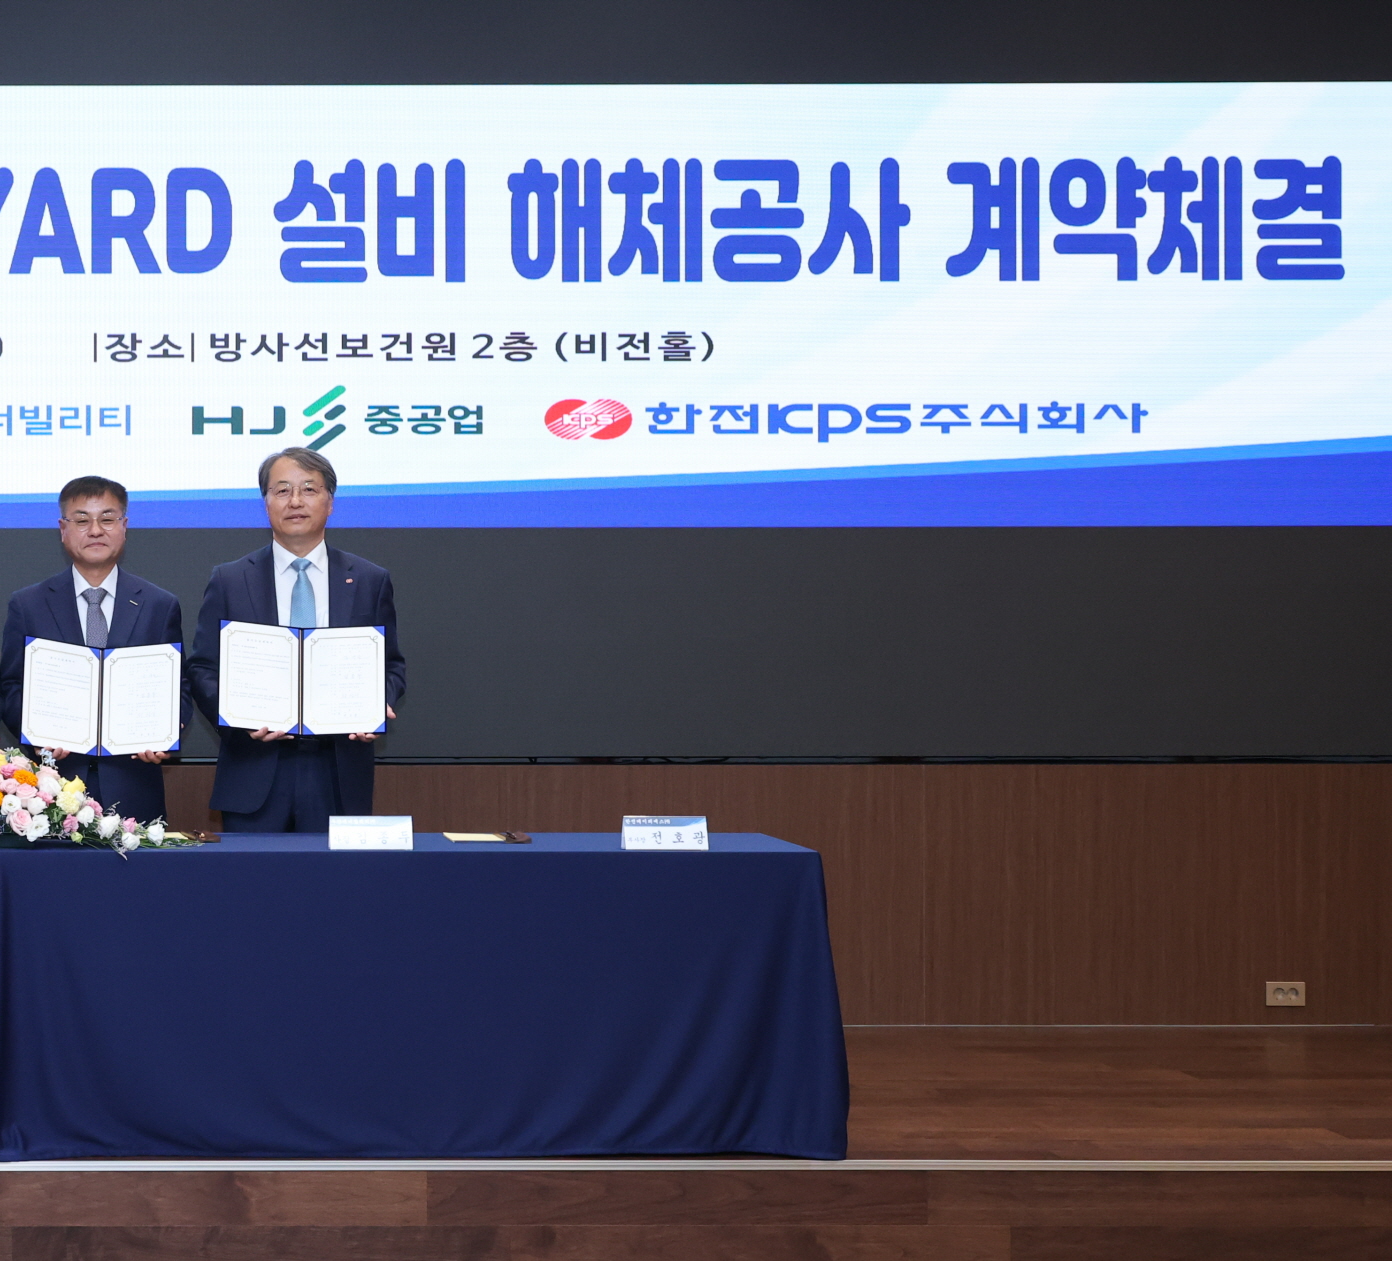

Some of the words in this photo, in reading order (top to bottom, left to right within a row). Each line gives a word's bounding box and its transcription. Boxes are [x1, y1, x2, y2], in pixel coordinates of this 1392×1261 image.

[274, 159, 465, 283] 설비
[508, 158, 910, 282] 해체공사
[946, 156, 1345, 281] 계약체결
[210, 332, 458, 363] 방사선보건원
[471, 332, 538, 363] 2층
[555, 331, 714, 363] (비전홀)
[191, 405, 287, 436] HJ
[364, 404, 484, 436] 중공업
[645, 401, 1149, 443] 한전KPS주식회사
